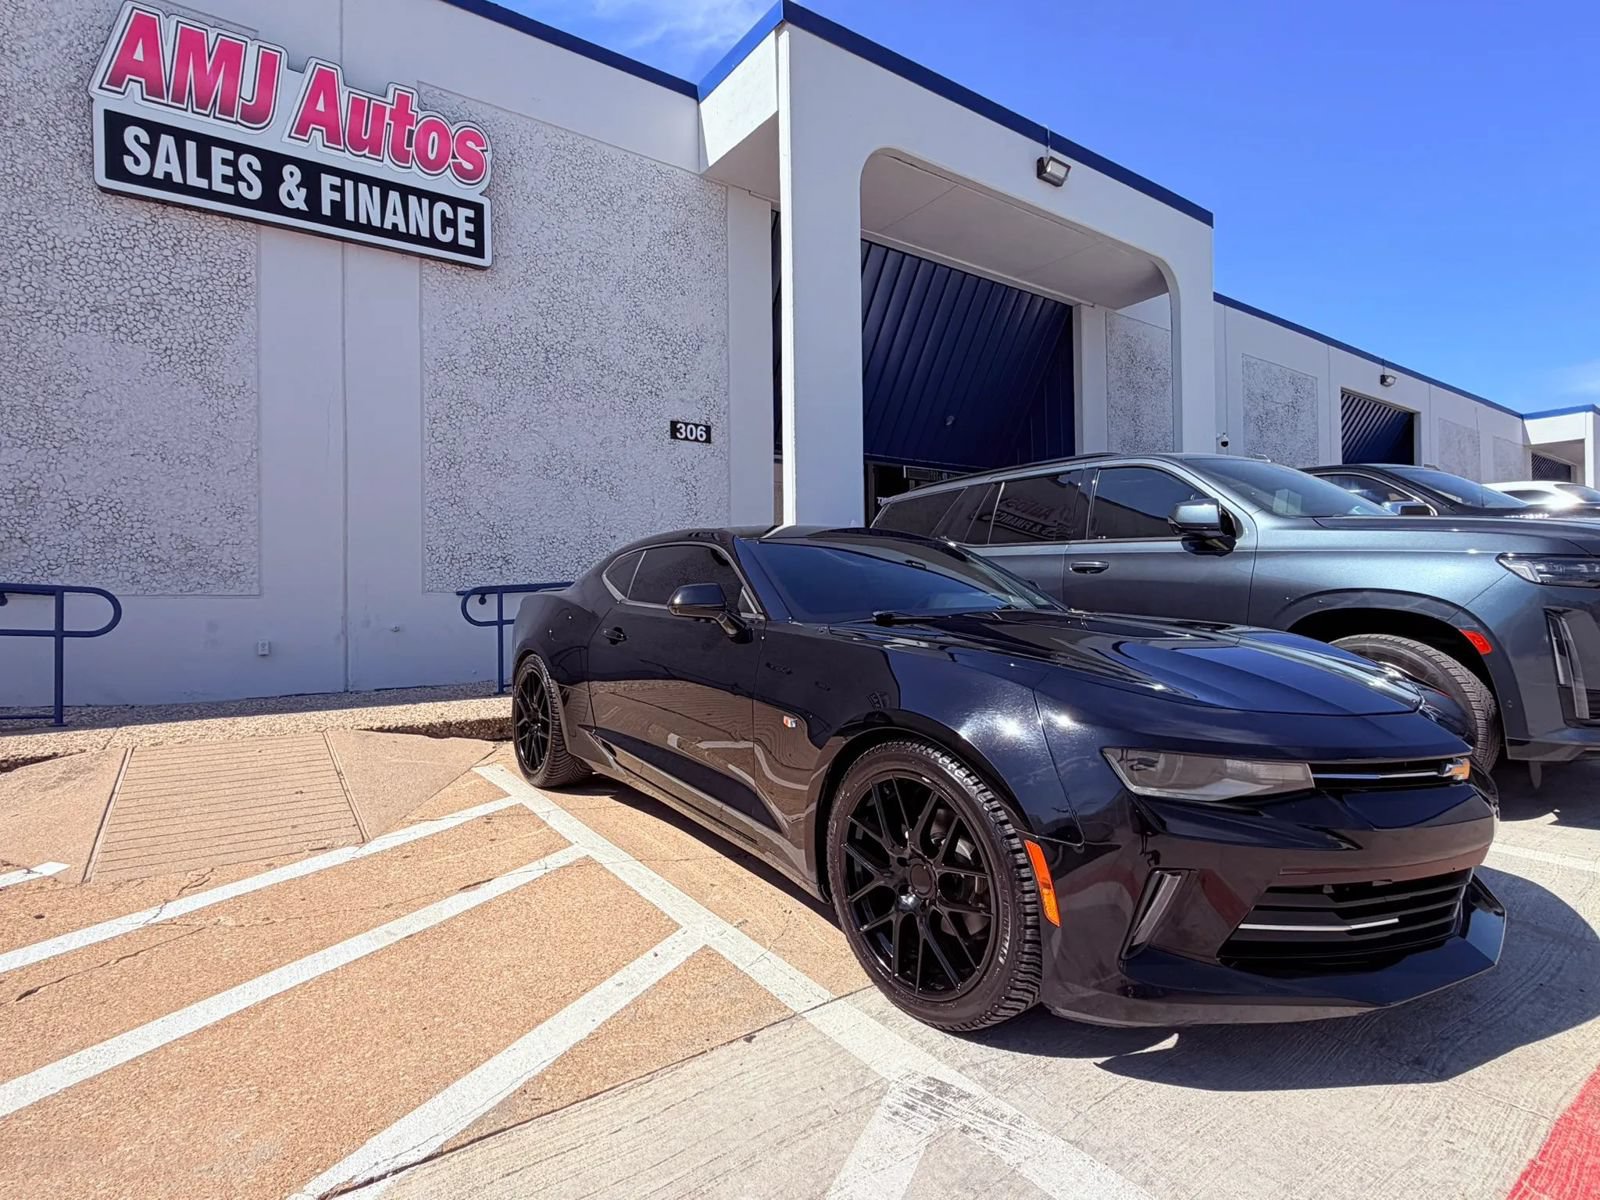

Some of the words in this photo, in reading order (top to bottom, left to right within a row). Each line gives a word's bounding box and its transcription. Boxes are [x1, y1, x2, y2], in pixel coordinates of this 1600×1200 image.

[100, 9, 282, 126] AMJ
[289, 65, 488, 184] Autos
[123, 126, 263, 201] SALES
[278, 164, 309, 211] &
[321, 173, 476, 248] FINANCE
[676, 423, 706, 441] 306
